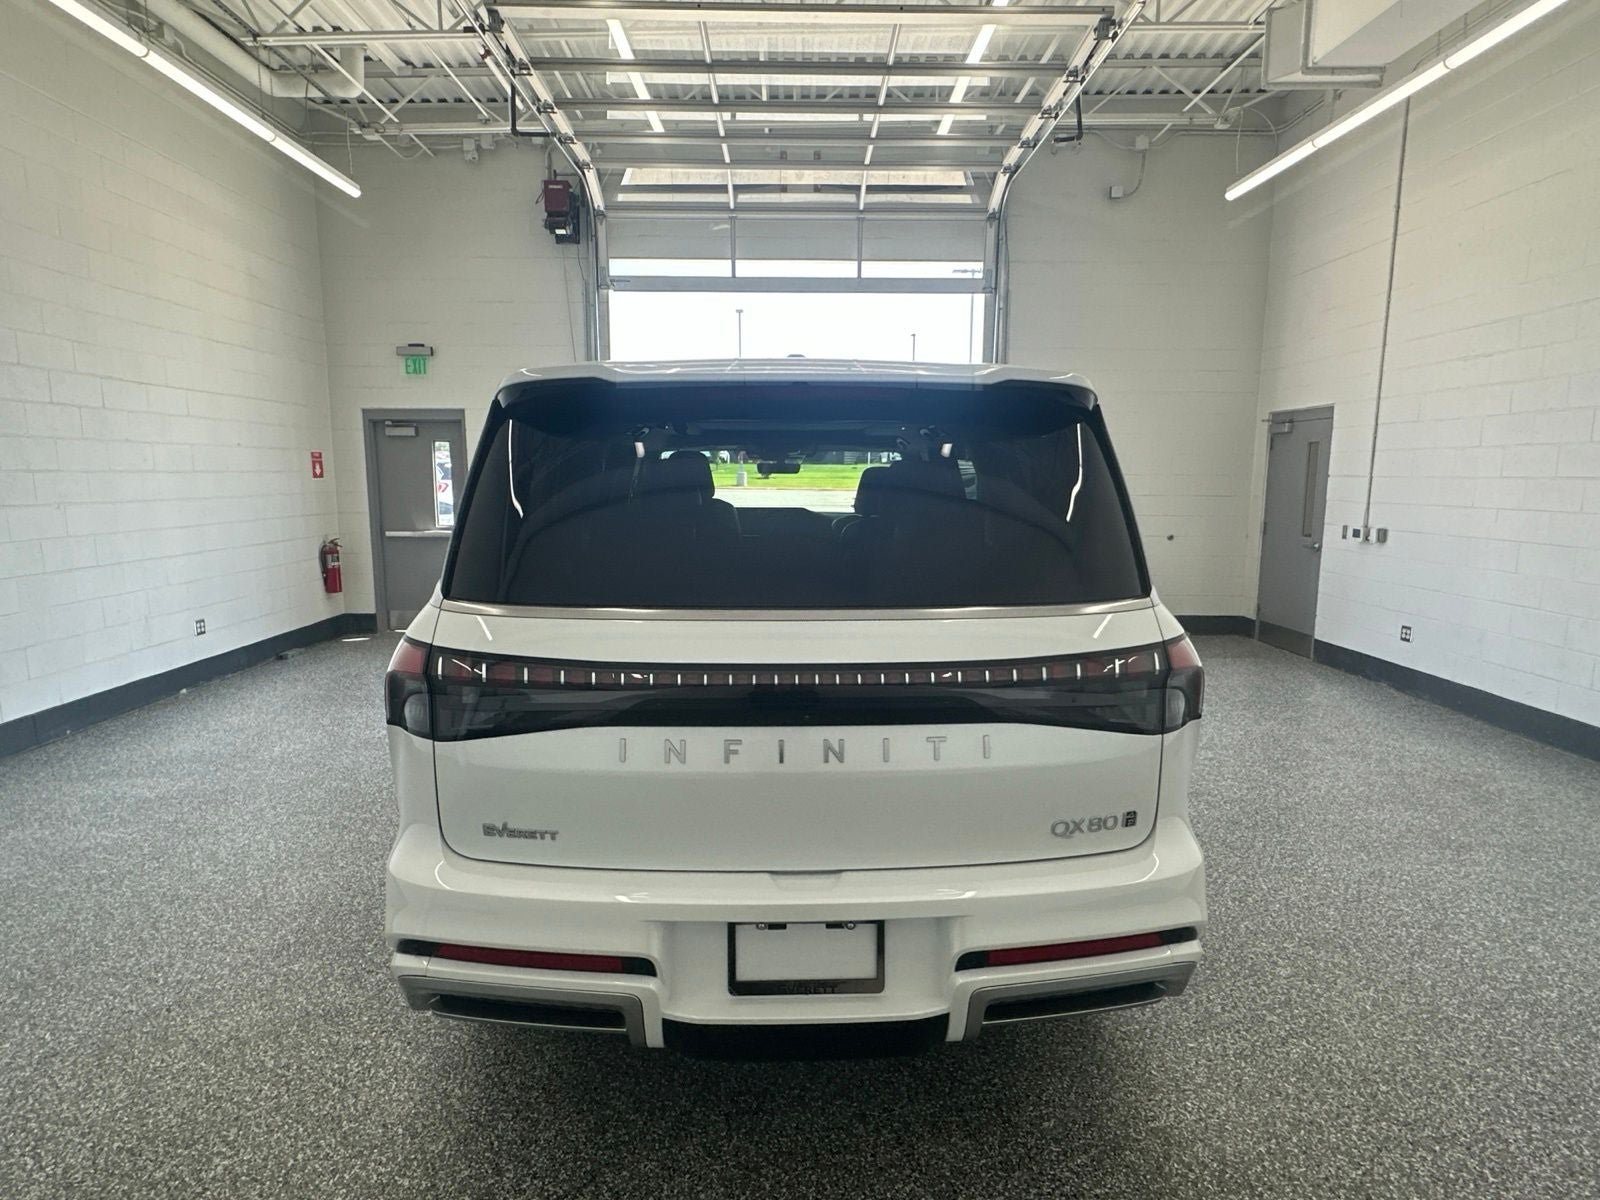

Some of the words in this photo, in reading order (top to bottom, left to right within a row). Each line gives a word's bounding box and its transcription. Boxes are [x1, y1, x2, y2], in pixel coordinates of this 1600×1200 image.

[405, 357, 427, 375] EXIT
[619, 734, 993, 764] INFINITI
[1050, 815, 1119, 840] QX80
